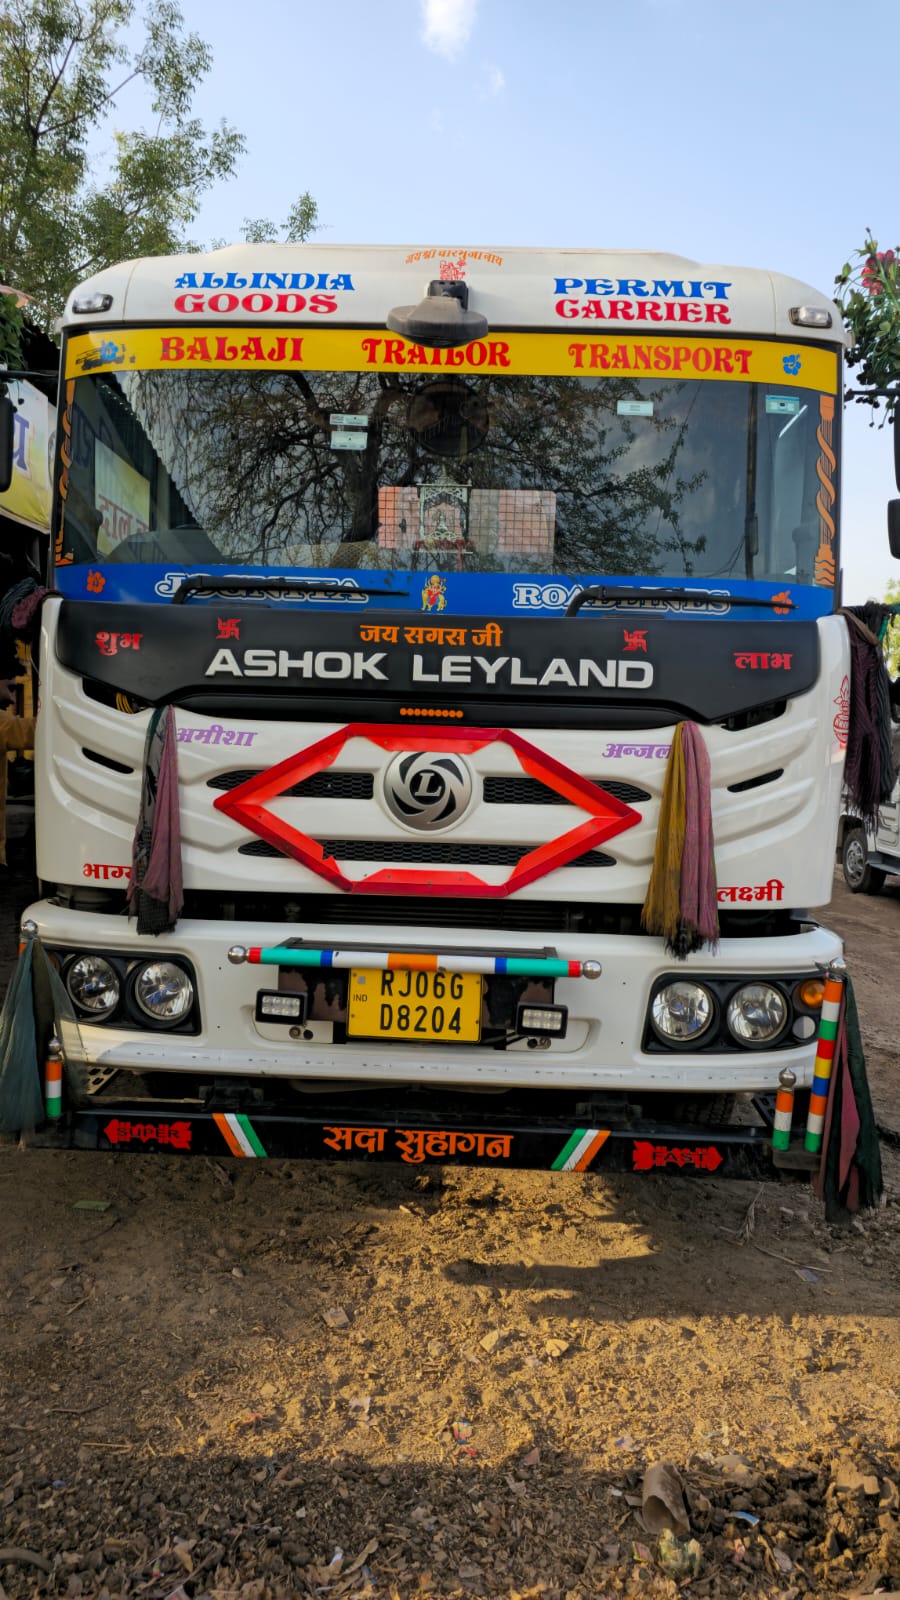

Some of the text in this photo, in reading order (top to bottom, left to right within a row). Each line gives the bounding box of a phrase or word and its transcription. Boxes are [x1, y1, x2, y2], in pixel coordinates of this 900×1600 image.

[553, 277, 732, 300] PERMIT
[174, 293, 338, 314] GOODS
[555, 299, 732, 325] CARRIER
[160, 336, 753, 374] BALAJI TRAILOR TRANSPORT
[95, 631, 144, 656] शुभ
[360, 622, 503, 647] जय सगस जी
[205, 648, 653, 690] ASHOK LEYLAND
[733, 652, 793, 670] लाभ
[176, 724, 258, 746] अमीशा
[716, 879, 784, 902] लक्ष्मी
[381, 969, 463, 999] RJ06G
[353, 994, 368, 1002] IND
[380, 1003, 461, 1034] D8204
[323, 1127, 514, 1164] सदा सुहागन
